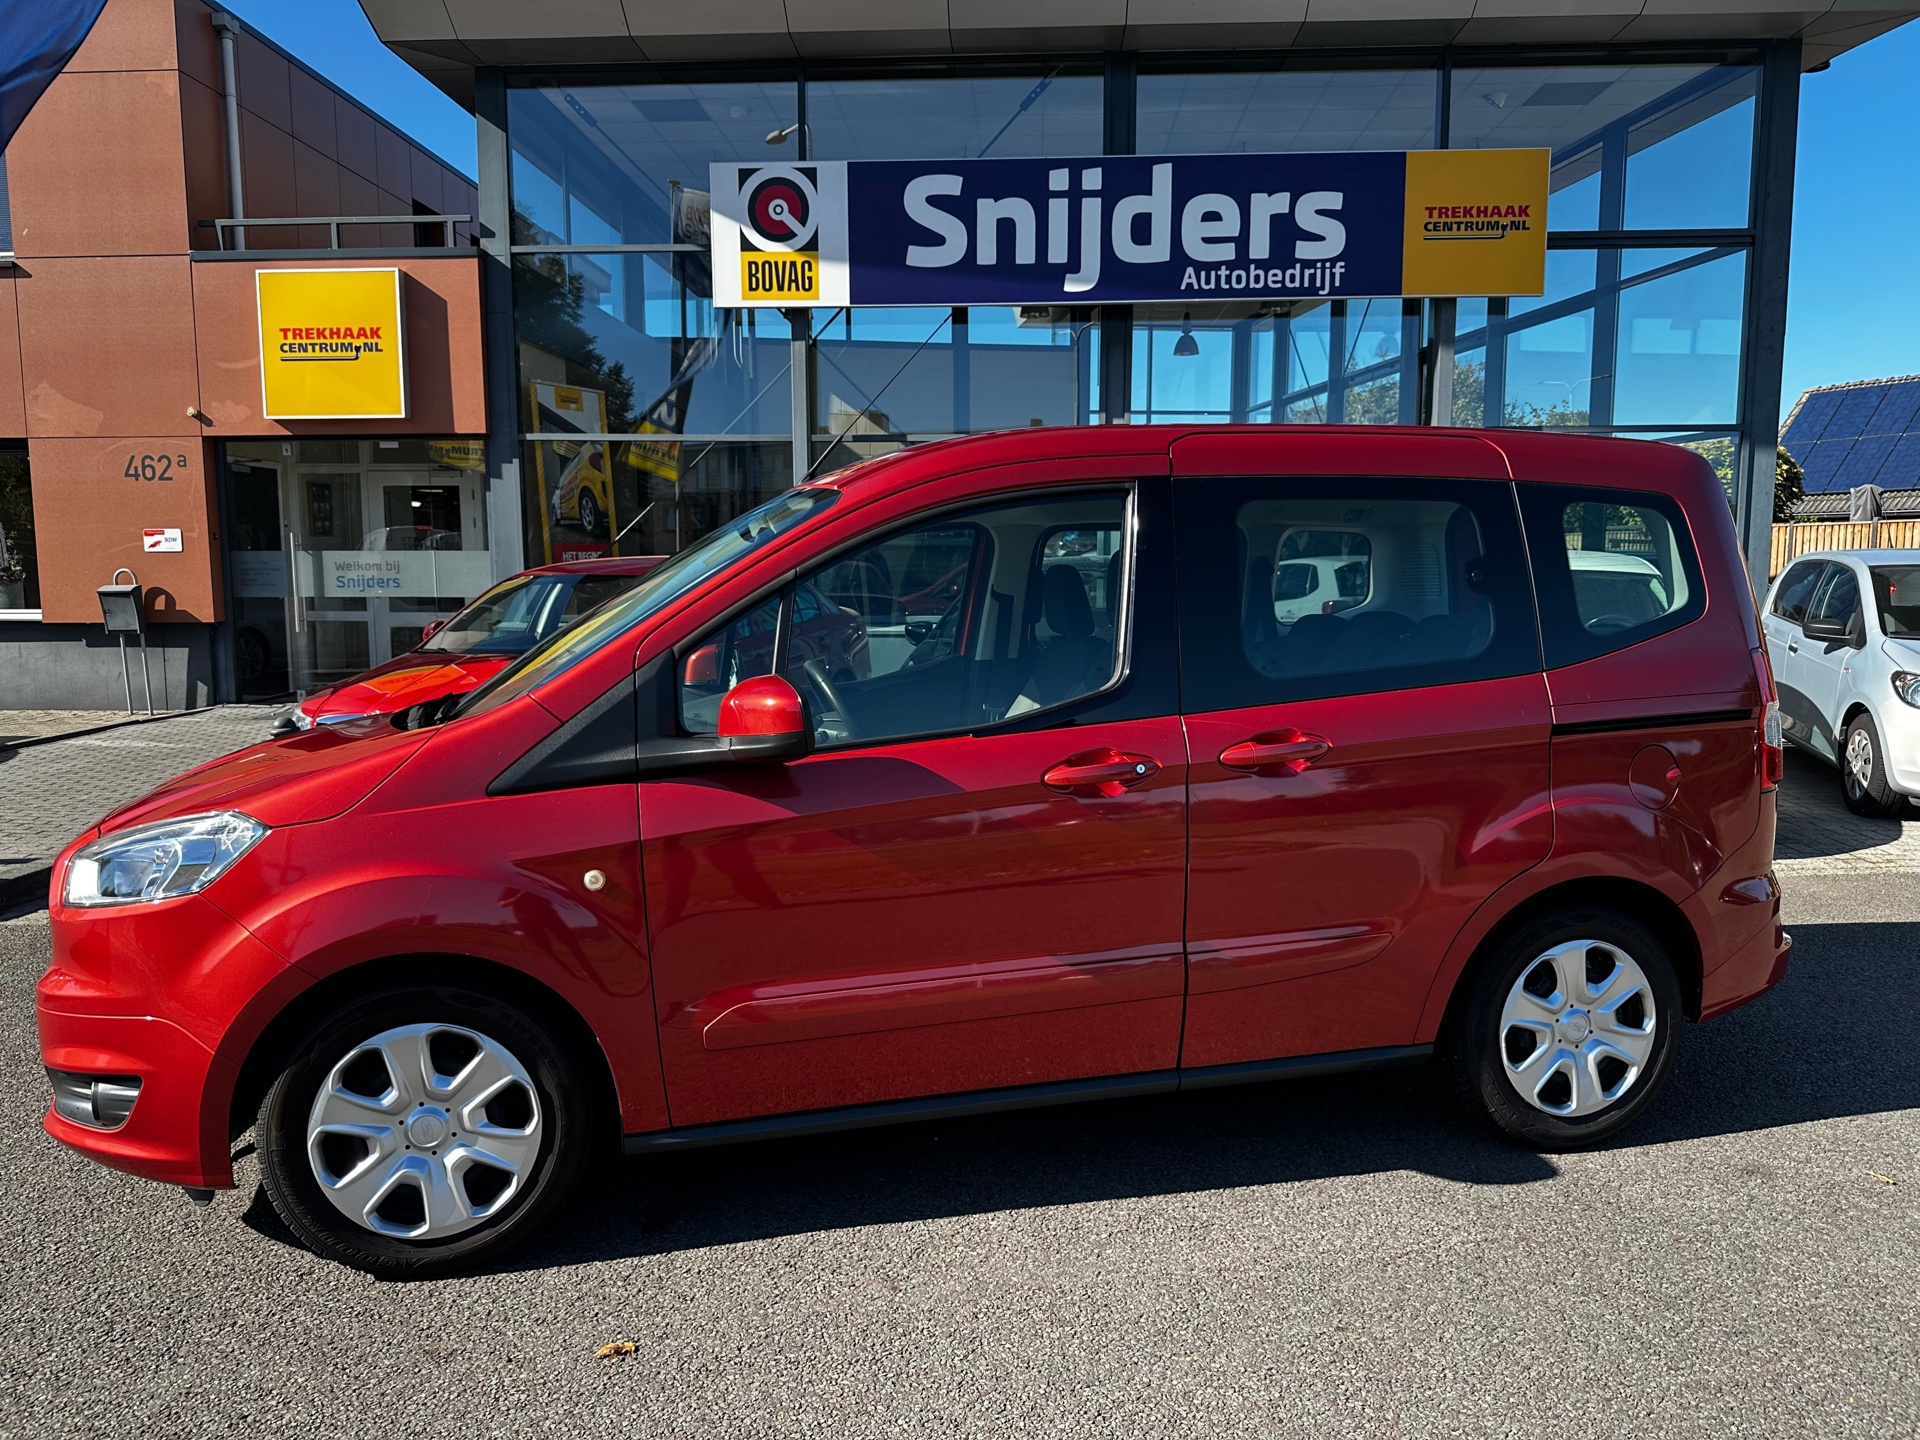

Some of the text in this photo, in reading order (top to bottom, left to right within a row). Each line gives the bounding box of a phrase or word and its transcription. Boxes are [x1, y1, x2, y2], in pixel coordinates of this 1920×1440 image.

[1424, 204, 1531, 219] TREKHAAK
[903, 162, 1347, 293] Snijders
[747, 259, 814, 293] BOVAG
[1180, 261, 1346, 295] Autobedrijf
[279, 326, 382, 341] TREKHAAK
[562, 551, 577, 562] HET
[334, 560, 400, 574] Welkom bij
[336, 575, 401, 593] Snijders
